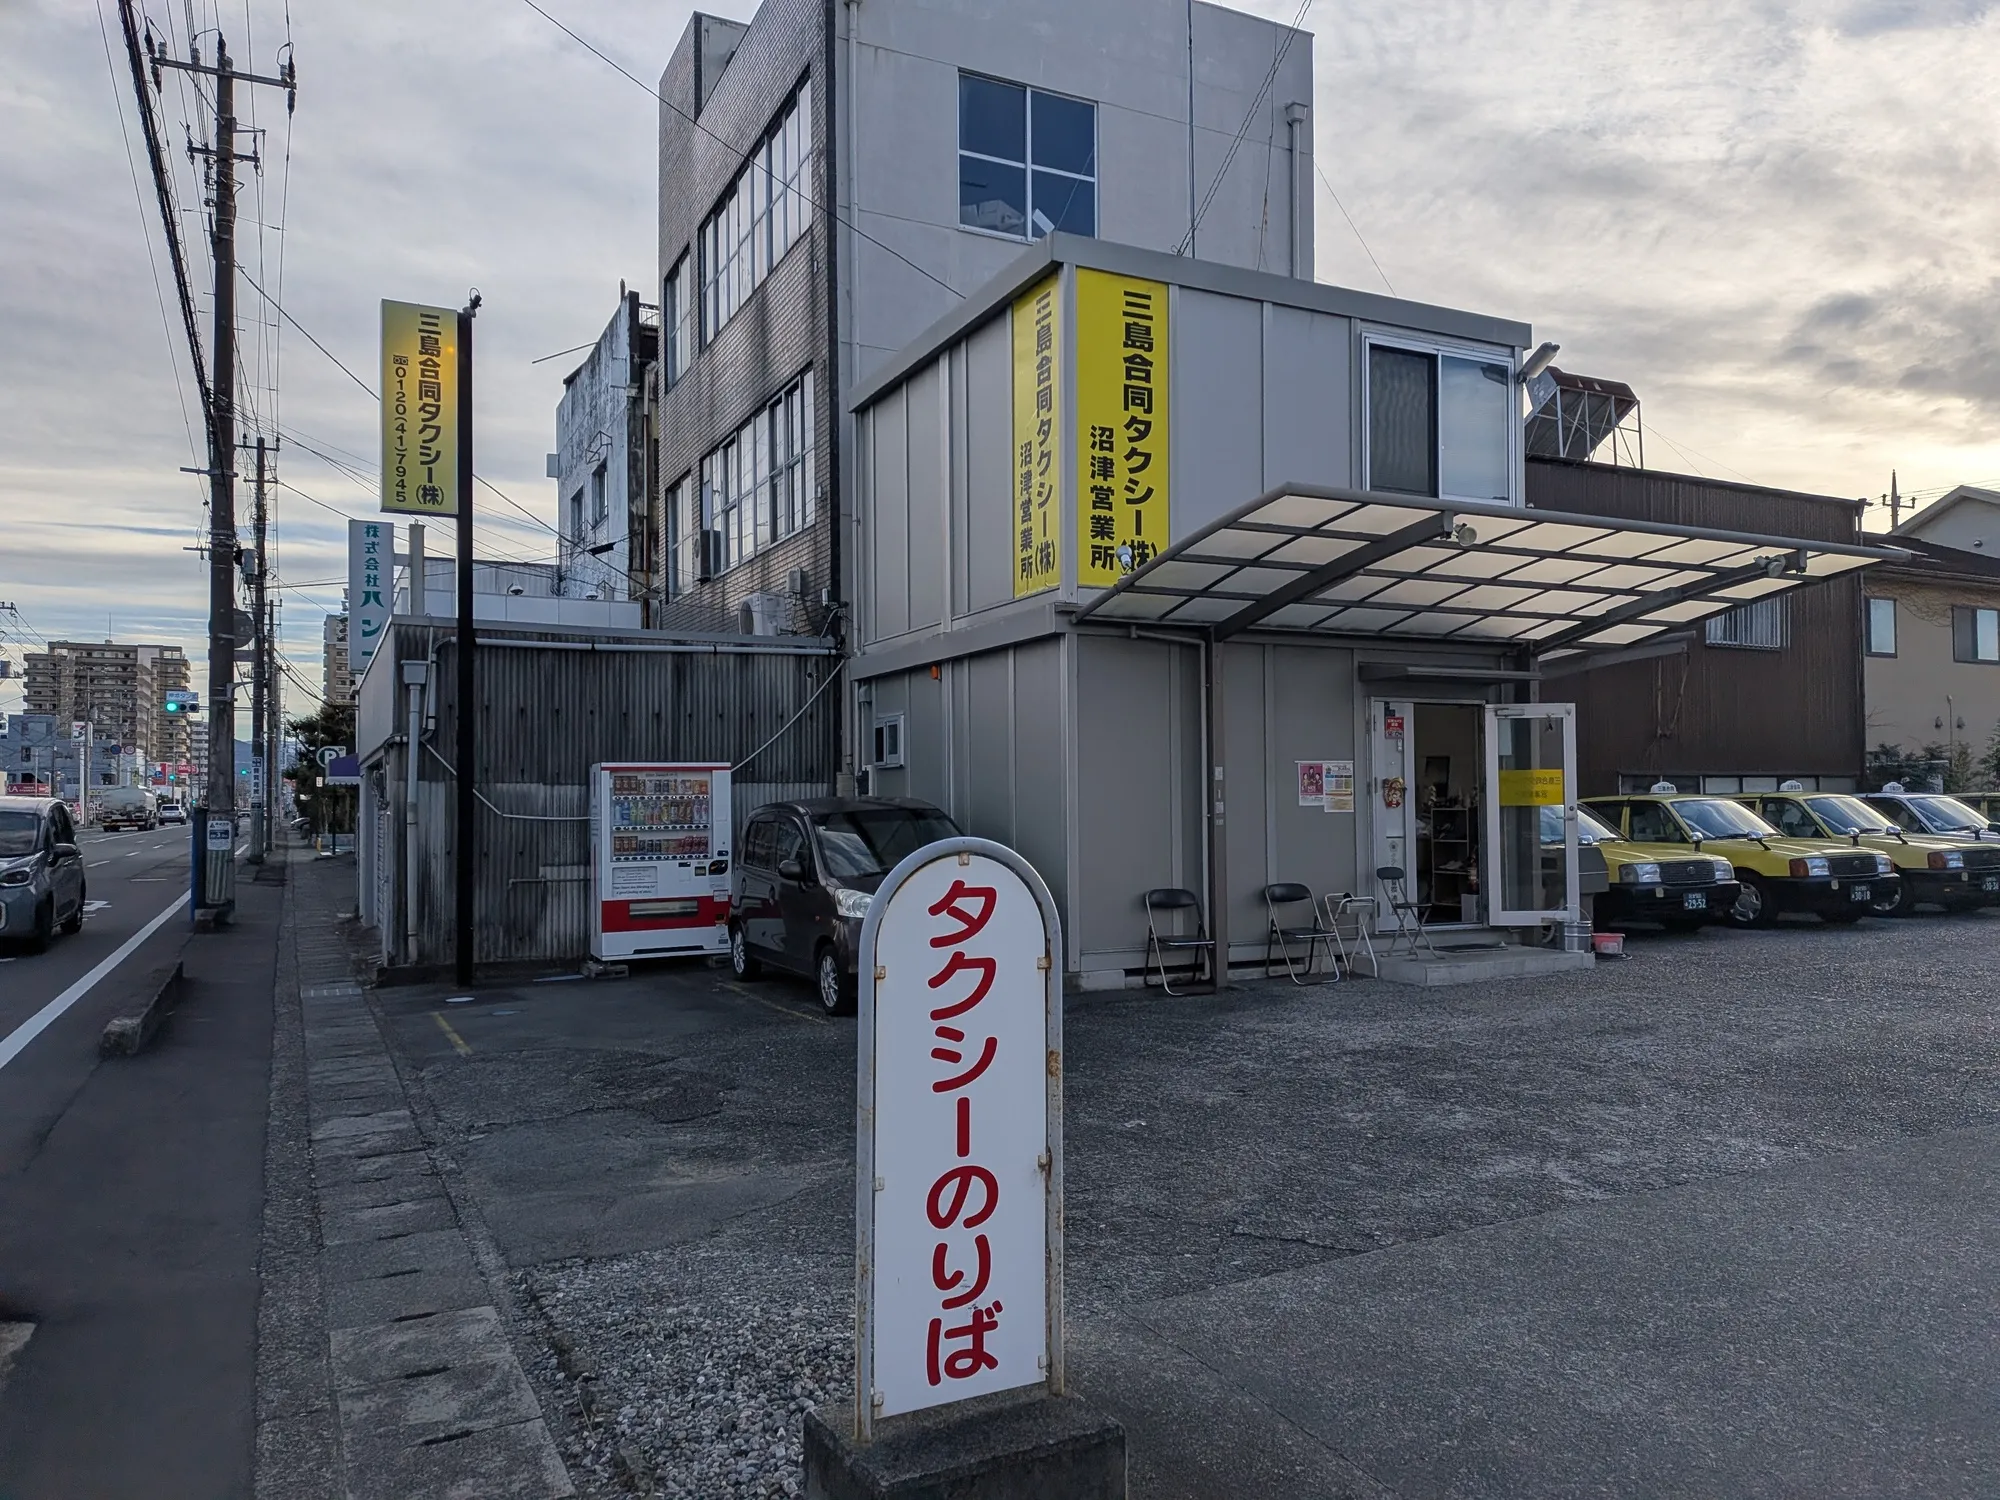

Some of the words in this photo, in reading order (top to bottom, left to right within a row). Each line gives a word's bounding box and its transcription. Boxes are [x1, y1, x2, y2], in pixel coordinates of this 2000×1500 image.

[415, 312, 445, 506] 三島合同タクシー(株)
[1035, 290, 1056, 576] 三島合同タクシー(株)
[1020, 440, 1033, 581] 沼津営業所
[1090, 424, 1115, 571] 沼津営業所
[360, 524, 385, 657] 株式会社ハン
[1688, 899, 1707, 908] 29-52
[927, 880, 1003, 1387] タクシーのりば
